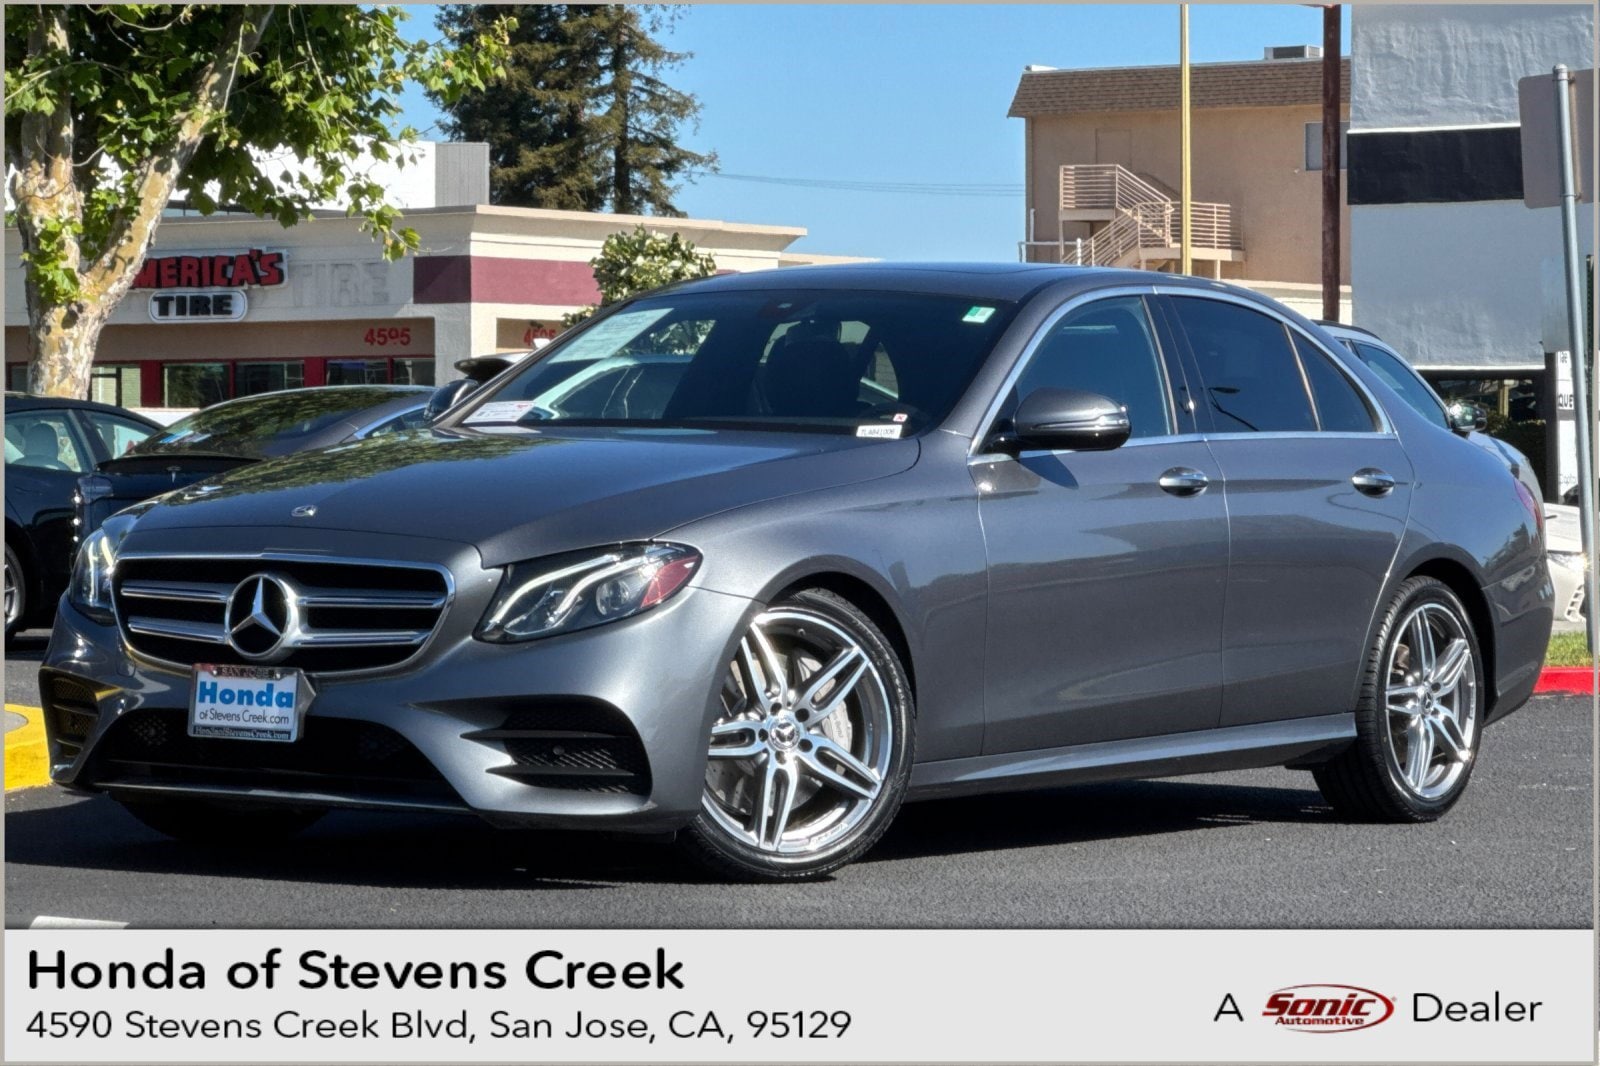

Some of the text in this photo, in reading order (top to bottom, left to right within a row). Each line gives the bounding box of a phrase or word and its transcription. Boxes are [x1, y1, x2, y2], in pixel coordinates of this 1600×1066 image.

[132, 250, 284, 288] MERICA'S
[153, 294, 233, 316] TIRE
[199, 681, 294, 708] Honda
[199, 709, 209, 720] of
